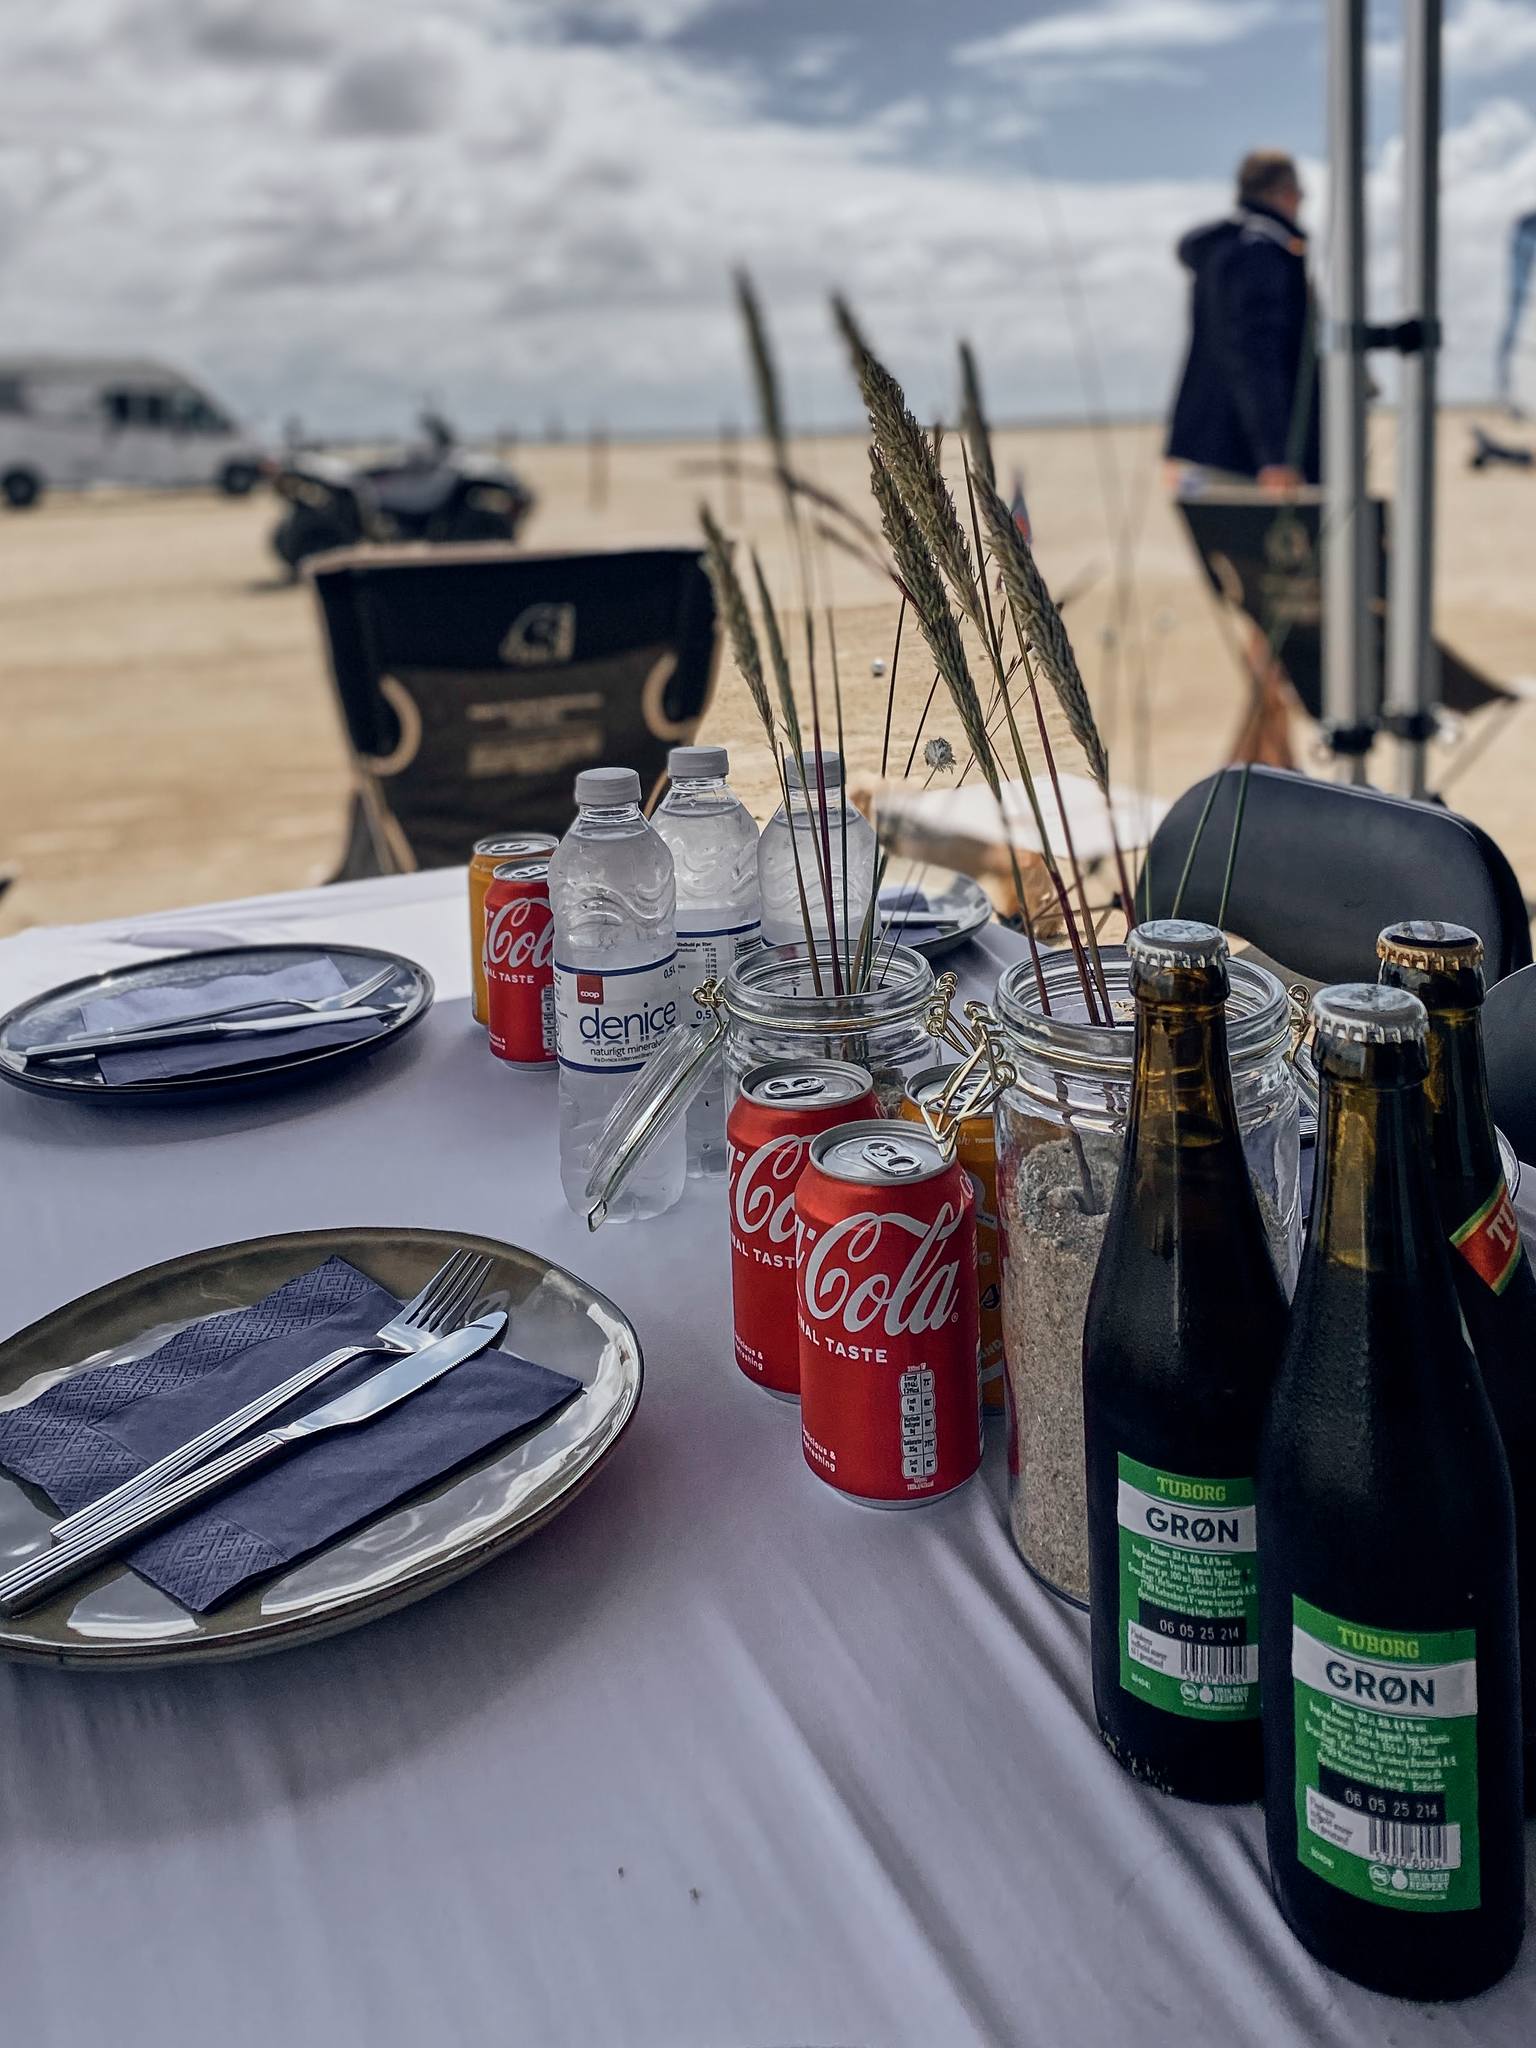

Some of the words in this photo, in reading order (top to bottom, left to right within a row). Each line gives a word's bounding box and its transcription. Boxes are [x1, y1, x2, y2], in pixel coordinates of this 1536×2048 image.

[498, 972, 535, 984] TASTE
[580, 990, 600, 999] coop
[579, 1001, 676, 1040] denice
[590, 1046, 626, 1058] naturligt
[824, 1336, 888, 1363] TASTE
[1156, 1476, 1226, 1502] TUBORG
[1145, 1507, 1239, 1543] GRØN
[1159, 1619, 1175, 1634] 06
[1179, 1624, 1195, 1637] 05
[1200, 1627, 1215, 1640] 25
[1220, 1627, 1239, 1640] 214
[1337, 1625, 1420, 1659] TUBORG
[1325, 1661, 1435, 1707] GRØN
[1344, 1788, 1362, 1807] 06
[1368, 1795, 1386, 1814] 05
[1393, 1802, 1410, 1817] 25
[1416, 1804, 1438, 1819] 214
